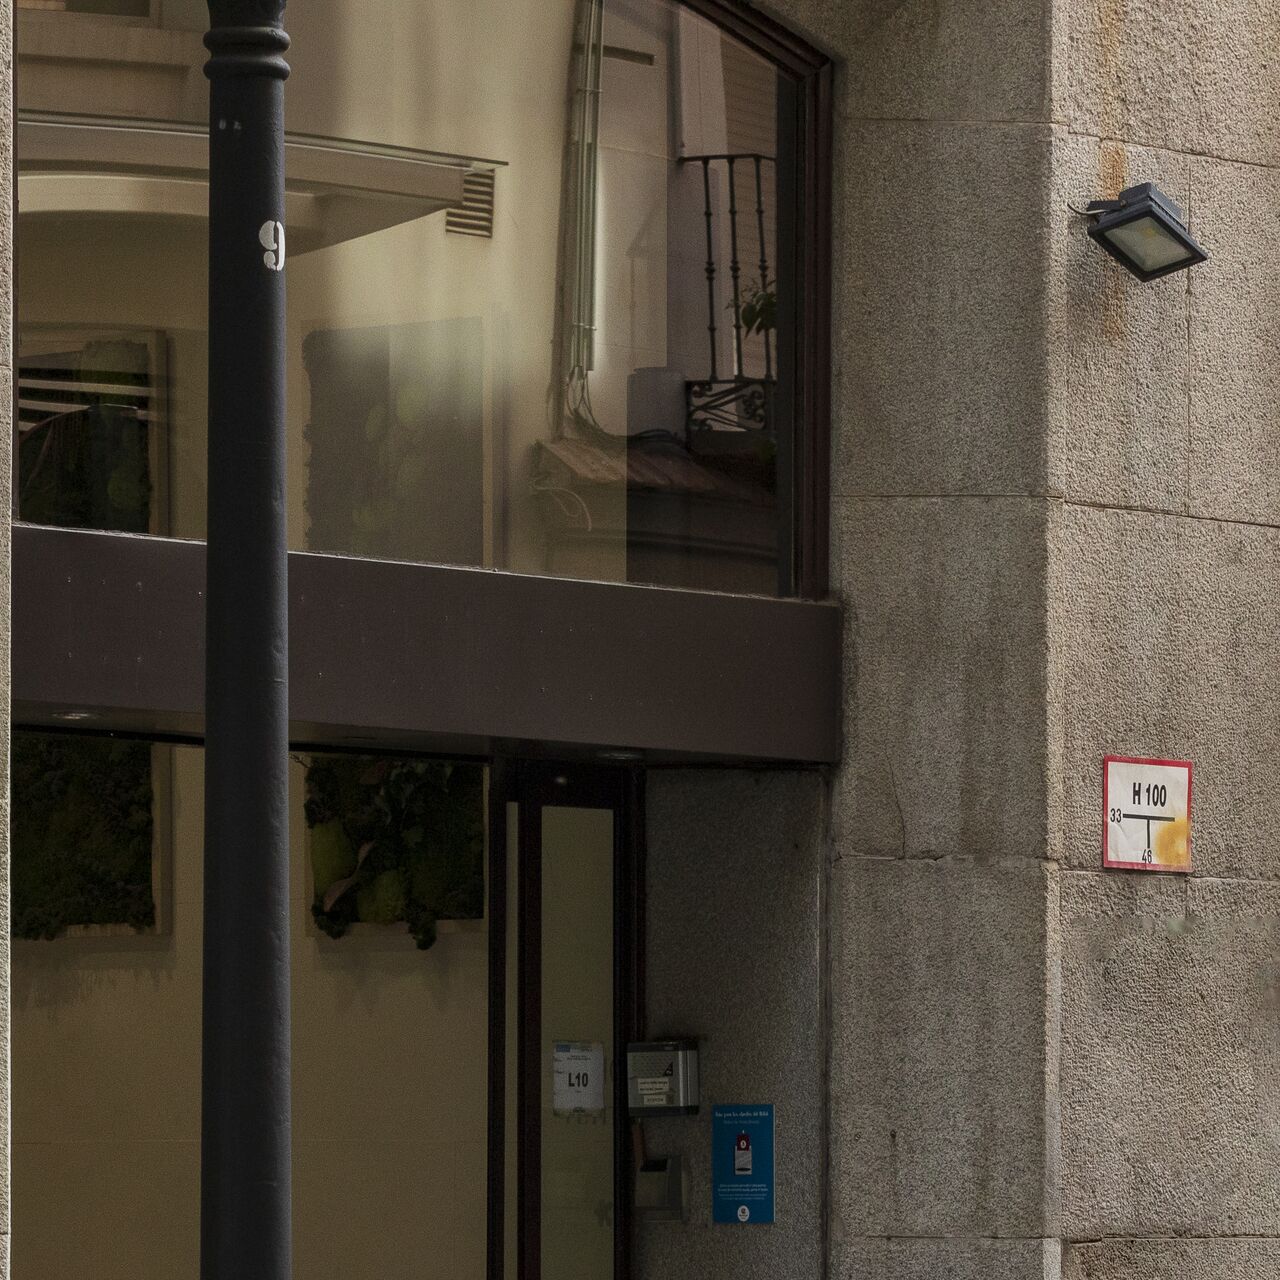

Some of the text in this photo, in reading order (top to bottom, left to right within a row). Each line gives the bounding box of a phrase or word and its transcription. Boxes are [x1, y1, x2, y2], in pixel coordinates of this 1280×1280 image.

[258, 220, 286, 271] 9
[1132, 782, 1167, 807] H 100
[1110, 808, 1122, 823] 33
[1141, 849, 1153, 864] 46
[568, 1072, 589, 1087] L10
